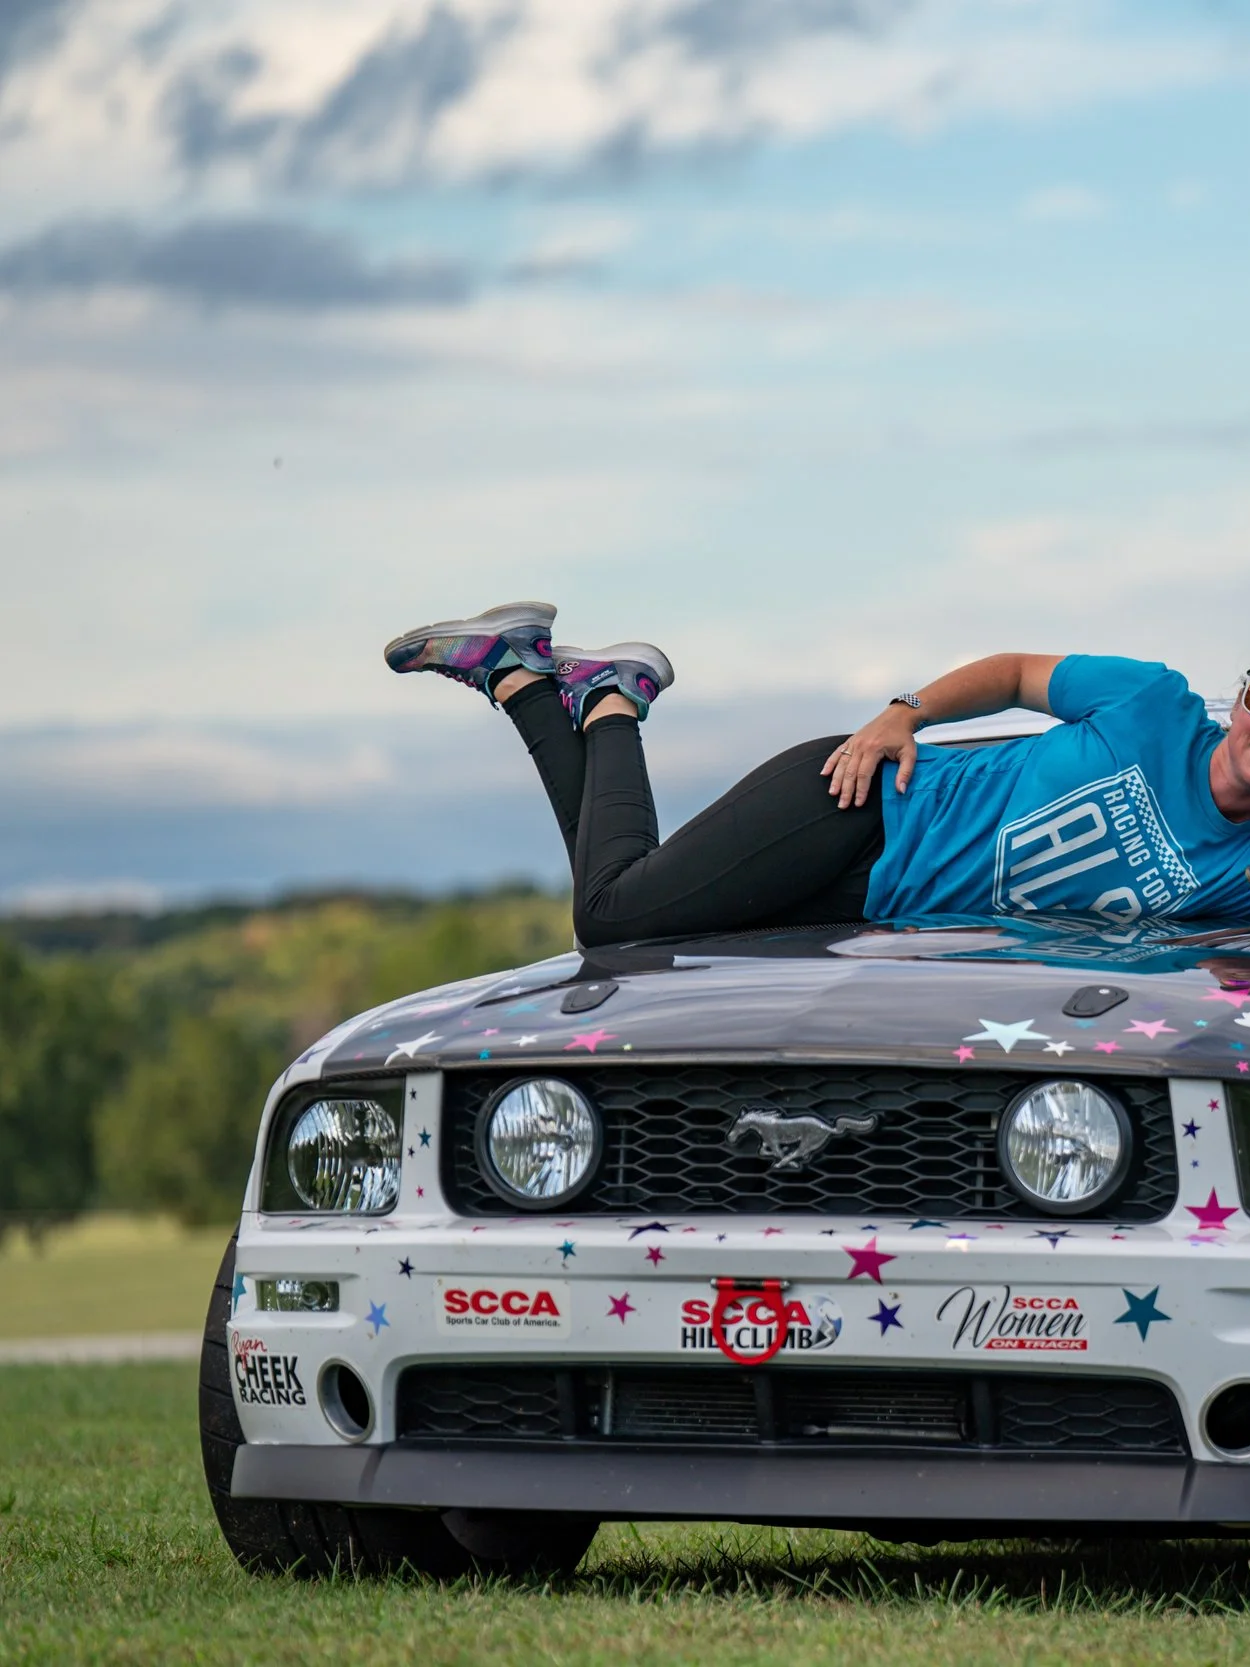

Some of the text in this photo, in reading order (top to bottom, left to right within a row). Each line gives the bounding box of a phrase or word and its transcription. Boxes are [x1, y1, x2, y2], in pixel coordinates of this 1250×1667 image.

[1103, 788, 1171, 910] RACING FOR
[444, 1289, 560, 1316] SCCA
[681, 1300, 811, 1326] SCCA
[1012, 1297, 1078, 1310] SCCA
[445, 1316, 472, 1326] Sports
[475, 1316, 488, 1325] Car
[491, 1316, 510, 1326] Club
[512, 1317, 521, 1326] of
[936, 1285, 1086, 1350] Women
[231, 1331, 267, 1371] Ryan
[991, 1340, 1082, 1349] ON TRACK
[235, 1355, 303, 1389] CHEEK
[239, 1387, 306, 1405] RACING
